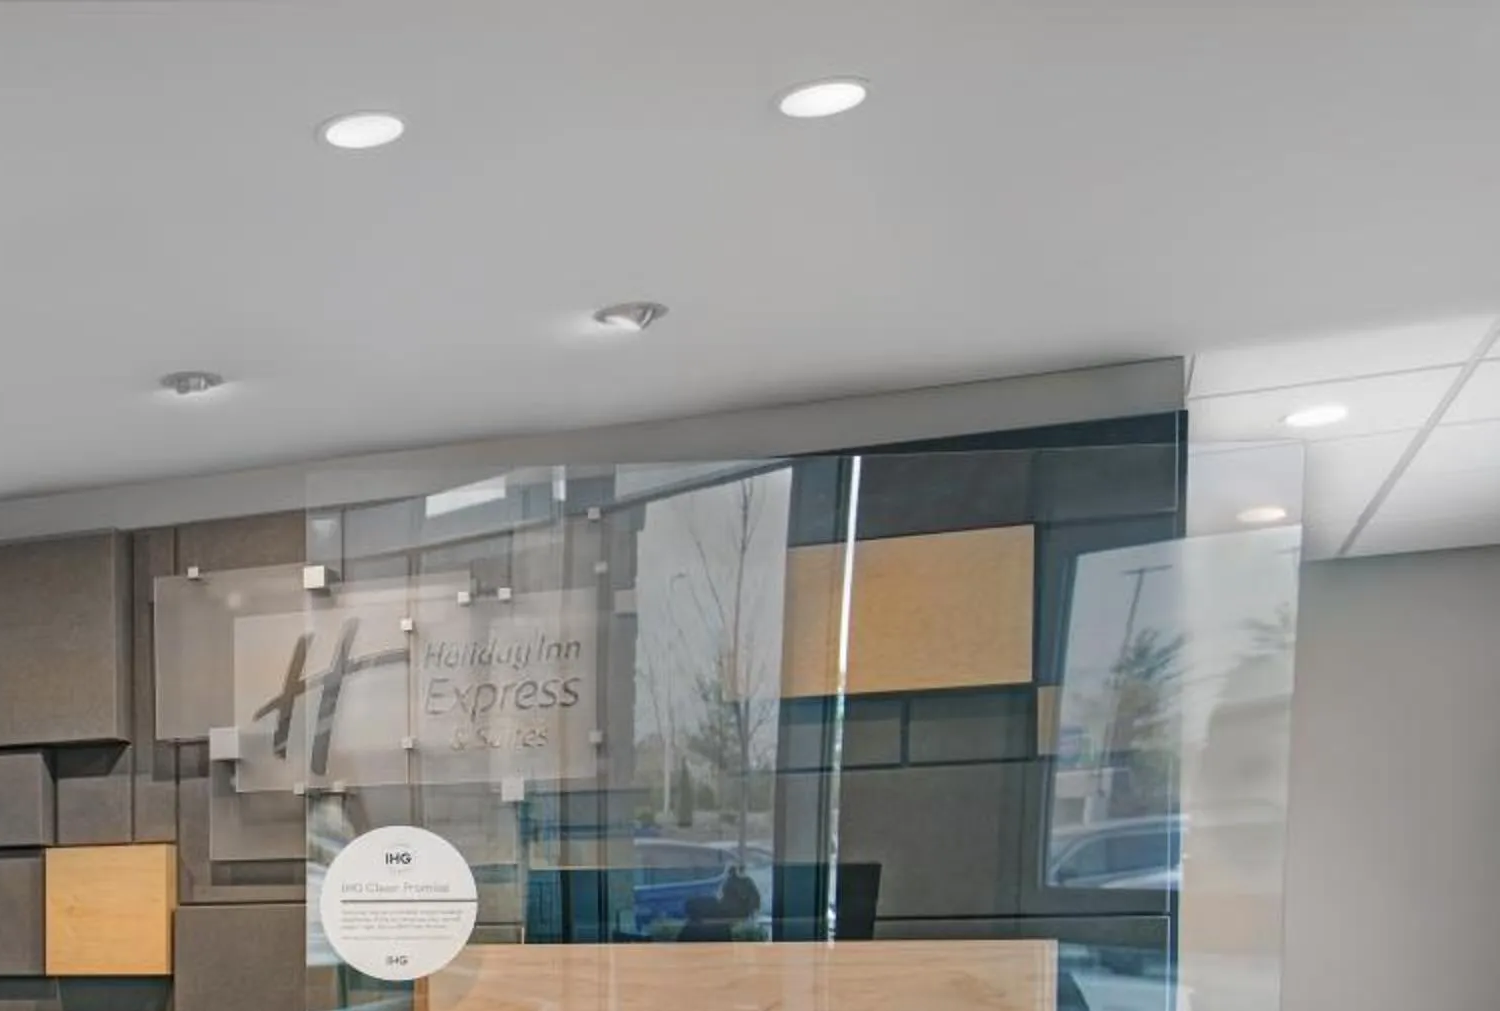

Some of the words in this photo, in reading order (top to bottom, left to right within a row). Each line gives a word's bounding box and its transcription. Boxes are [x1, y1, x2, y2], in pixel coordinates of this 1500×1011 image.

[424, 638, 531, 670] Holiday
[537, 633, 582, 661] Inn
[425, 676, 583, 723] Express
[472, 726, 549, 749] Suites
[384, 852, 412, 865] IHG
